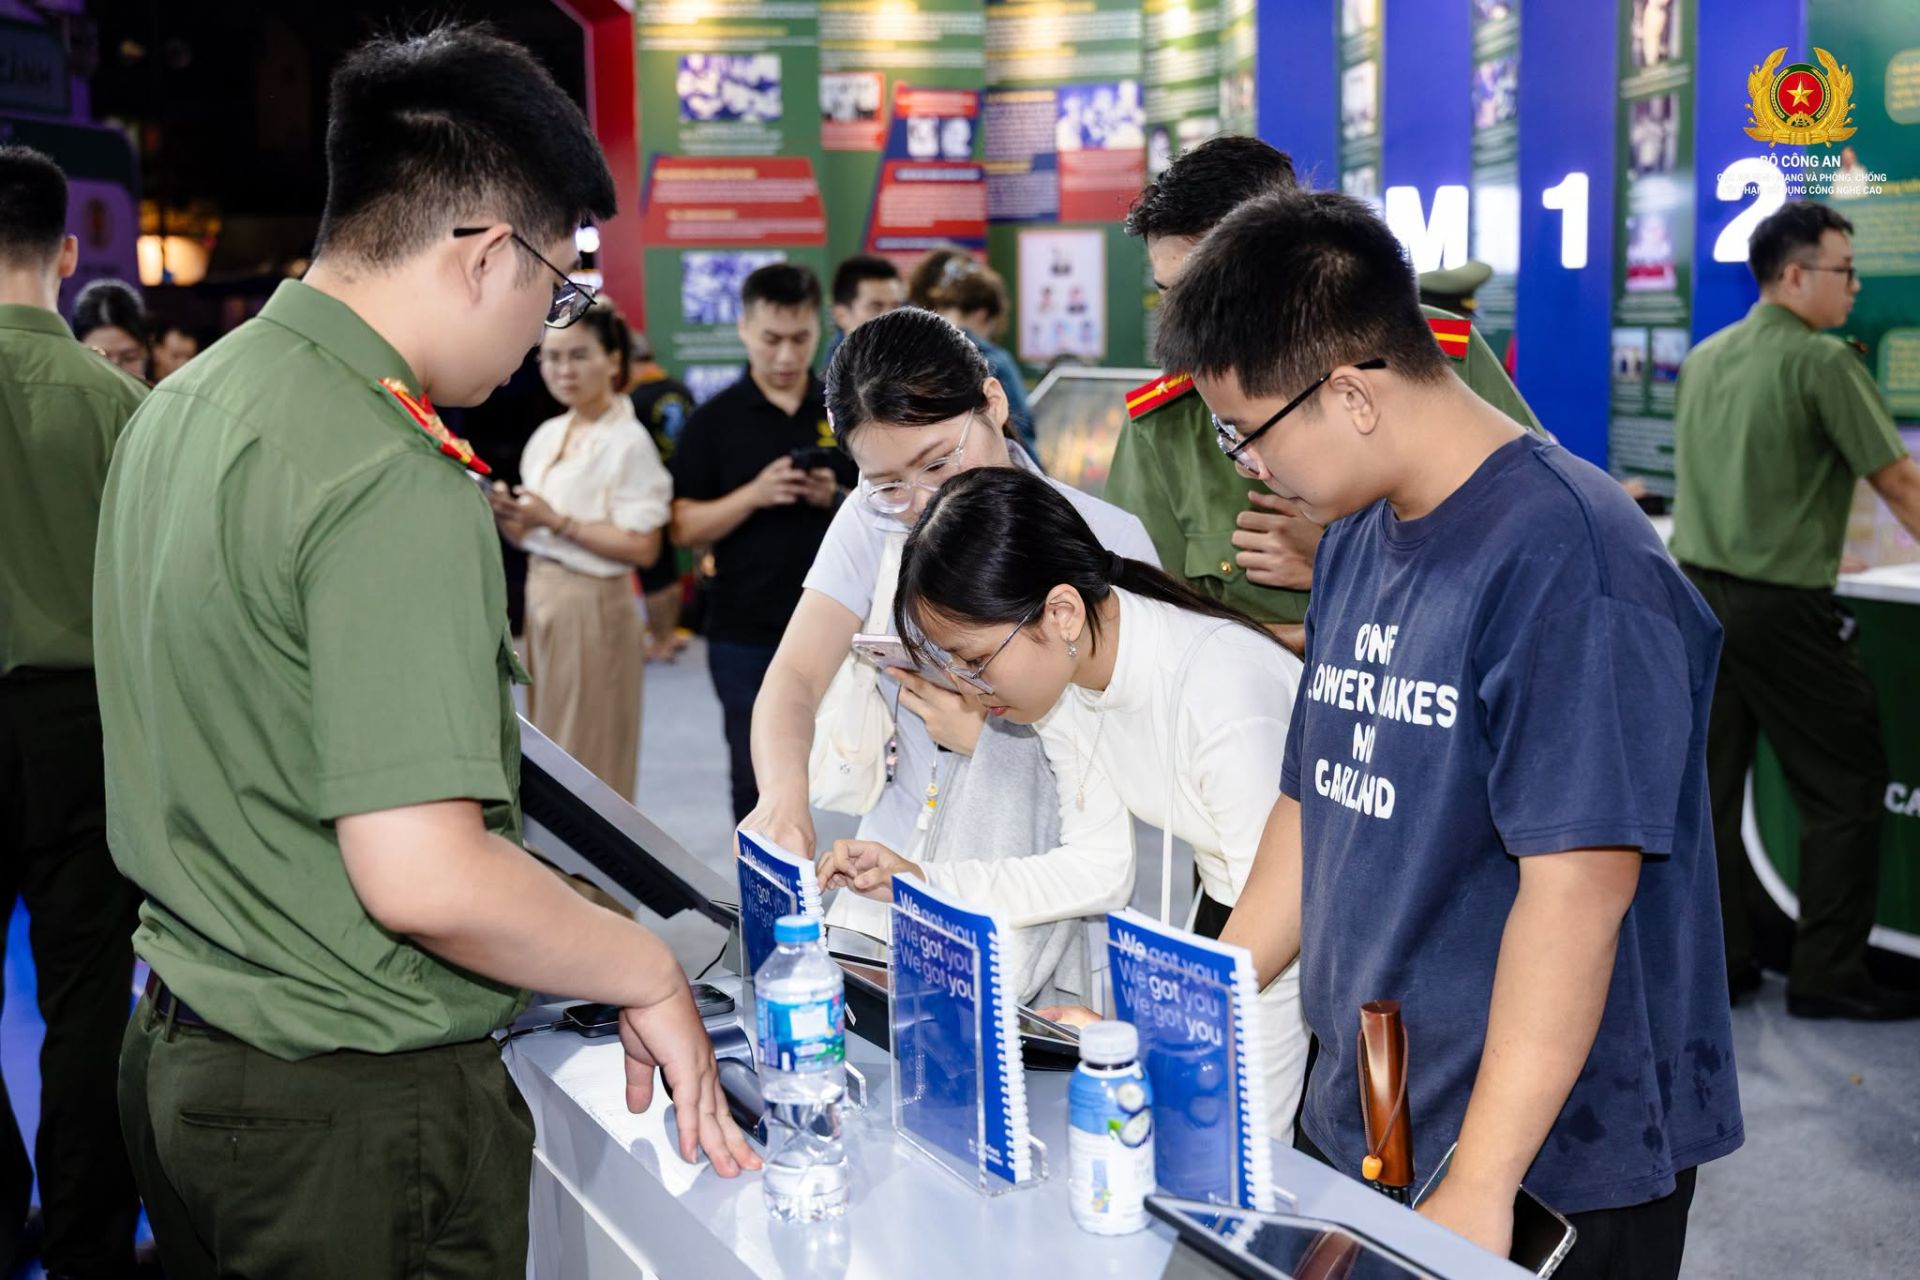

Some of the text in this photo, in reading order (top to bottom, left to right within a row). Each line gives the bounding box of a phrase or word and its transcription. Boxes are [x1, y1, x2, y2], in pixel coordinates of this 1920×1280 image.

[1542, 172, 1589, 269] 1
[1712, 157, 1787, 263] 2
[1308, 663, 1376, 715] OWER
[757, 884, 772, 906] got
[899, 890, 920, 915] We
[899, 916, 919, 948] We
[920, 935, 945, 962] got
[1117, 928, 1147, 962] We
[900, 944, 921, 973] We
[923, 961, 947, 988] got
[1117, 957, 1220, 1017] We got you
[1121, 984, 1223, 1047] We got you
